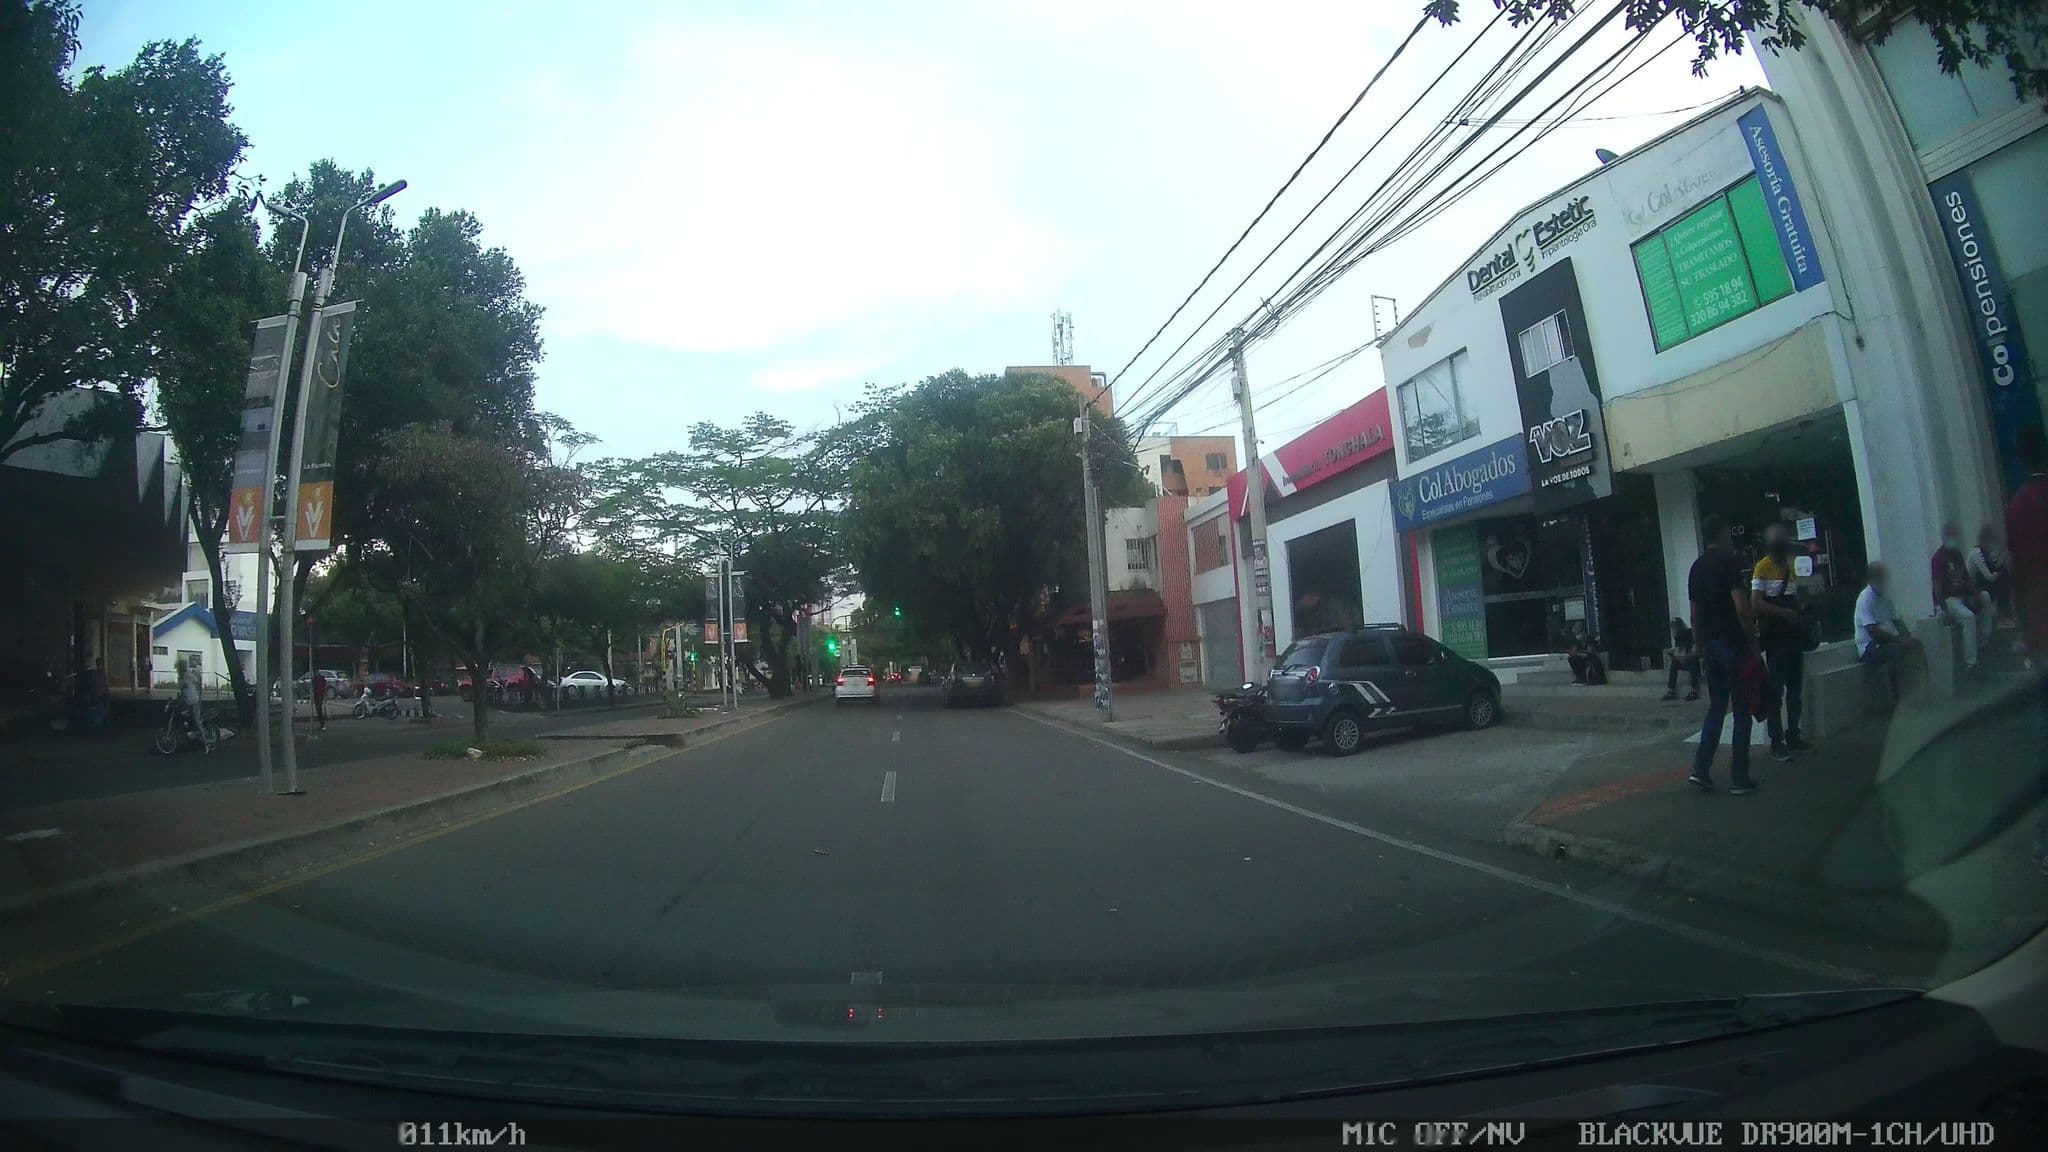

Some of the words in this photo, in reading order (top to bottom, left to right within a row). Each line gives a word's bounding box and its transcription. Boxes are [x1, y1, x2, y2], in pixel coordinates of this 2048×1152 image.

[1749, 126, 1782, 196] Asesoría
[1777, 196, 1808, 274] Gratuita
[1467, 243, 1516, 291] Dental
[1533, 196, 1594, 247] Estetic
[1690, 311, 1706, 328] 320
[1719, 298, 1730, 314] 94
[1730, 290, 1748, 308] 382
[1703, 287, 1719, 306] 595
[1720, 284, 1731, 296] 18
[1731, 276, 1744, 291] 94
[1419, 451, 1516, 503] ColAbogados
[1541, 480, 1549, 488] LA
[1562, 471, 1570, 481] DE
[1570, 465, 1590, 479] TODOS
